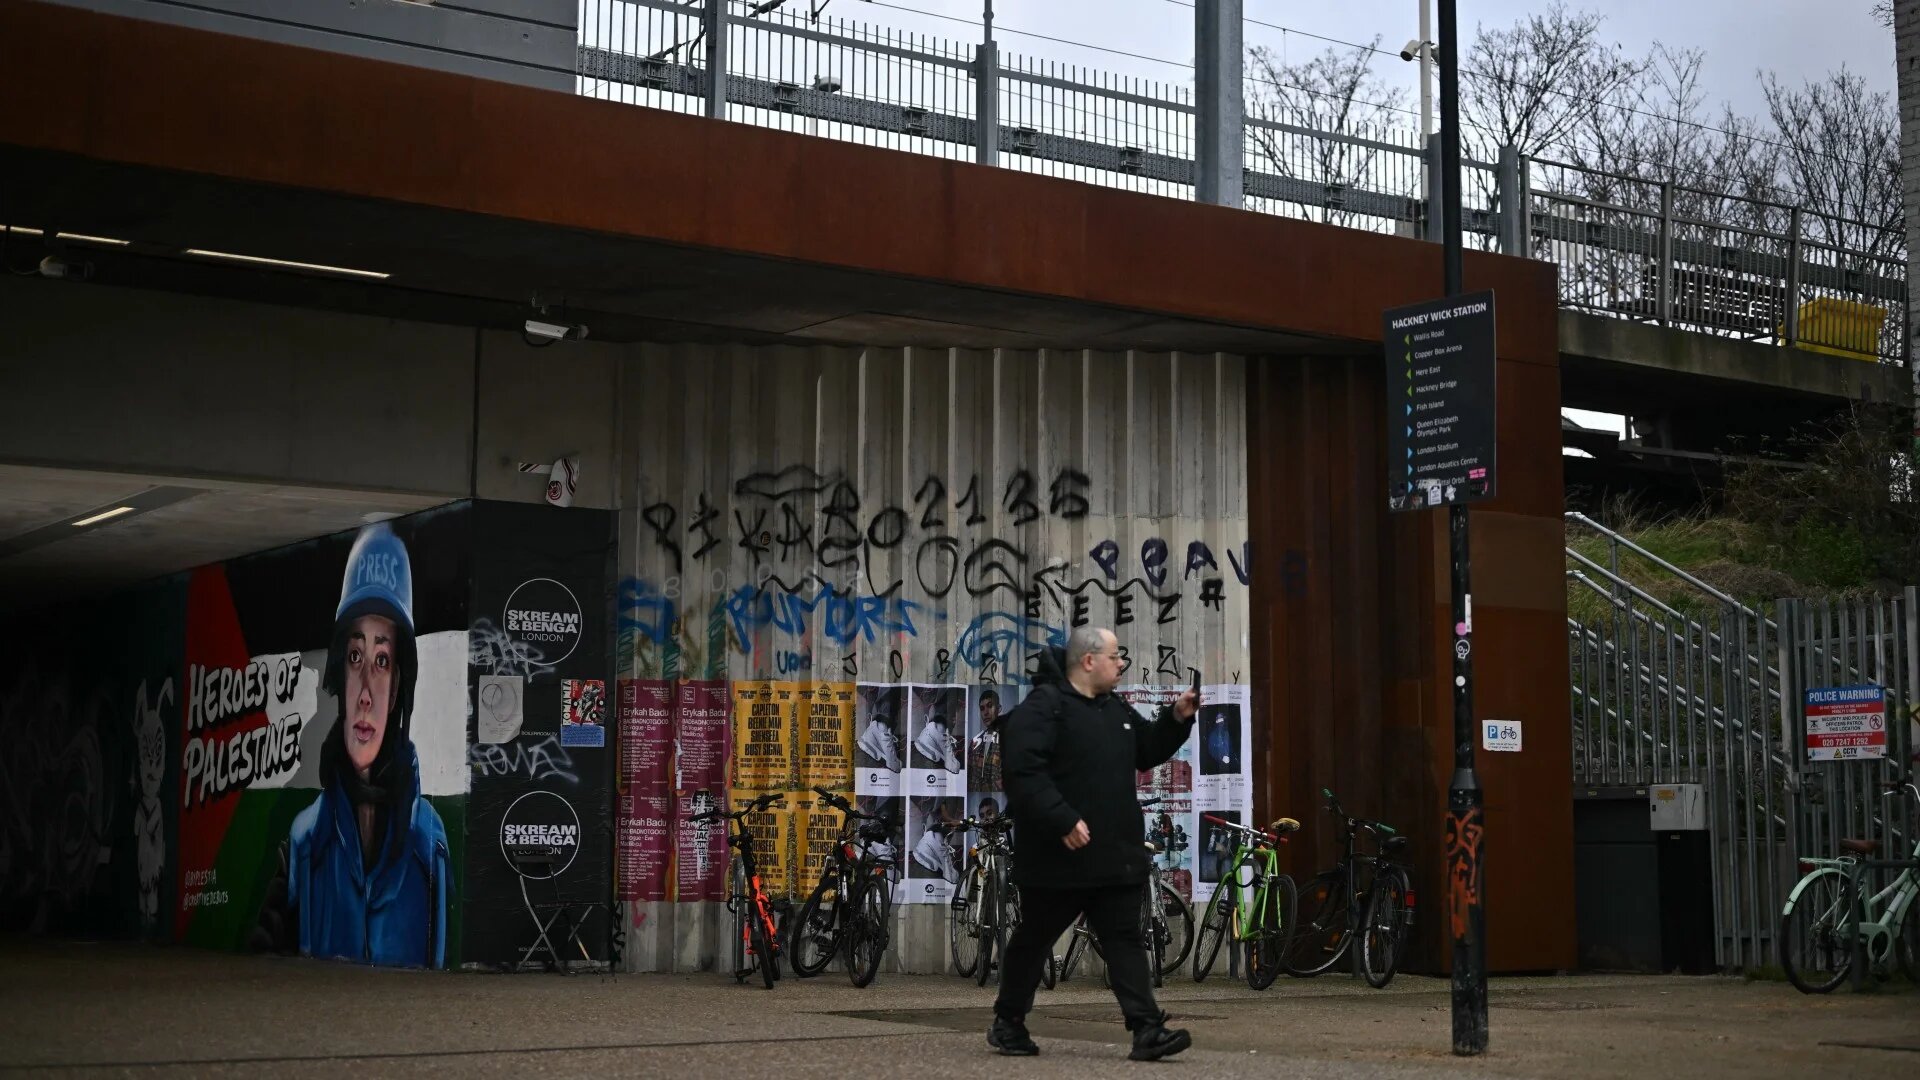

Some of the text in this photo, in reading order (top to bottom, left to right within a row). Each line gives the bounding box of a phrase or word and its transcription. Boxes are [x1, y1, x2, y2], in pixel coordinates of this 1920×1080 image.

[1392, 302, 1487, 329] HACKNEY WICK STATION
[1413, 329, 1445, 342] Wallis Road
[1414, 348, 1434, 360] Copper
[1445, 343, 1463, 354] Arena
[1415, 365, 1441, 377] Here East
[1416, 379, 1458, 394] Hackney Bridge
[1416, 400, 1445, 412] Fish Island
[1416, 415, 1459, 430] Queen Elizabeth
[1416, 425, 1451, 438] Olympic Park
[1416, 441, 1459, 456] London Stadium
[1417, 456, 1478, 473] London Aquatics Centre
[1451, 476, 1466, 486] Orbit
[357, 551, 399, 592] PRESS
[507, 609, 579, 624] SKREAM
[507, 620, 578, 634] & BENGA
[521, 632, 564, 642] LONDON
[187, 656, 301, 732] HEROES OF
[1136, 692, 1178, 703] HAMMERVI
[1809, 688, 1880, 702] POLICE WARNING
[623, 707, 669, 717] Erykah Badu
[682, 707, 726, 718] Erykah Badu
[751, 703, 780, 716] CAPLETON
[810, 703, 839, 717] CAPLETON
[748, 717, 782, 729] BEENIE MAN
[807, 717, 842, 730] BEENIE MAN
[810, 730, 838, 743] SHENSEEA
[1822, 739, 1834, 747] 020
[1835, 738, 1851, 746] 7247
[762, 743, 783, 756] SIGNAL
[805, 743, 843, 756] BUSY SIGNAL
[1842, 747, 1858, 755] CCTV
[620, 817, 667, 827] Erykah Badu
[747, 812, 777, 826] CAPLETON
[809, 814, 838, 827] CAPLETON
[504, 824, 577, 836] SKREAM
[747, 826, 765, 839] EENIE
[504, 834, 576, 846] & BENGA
